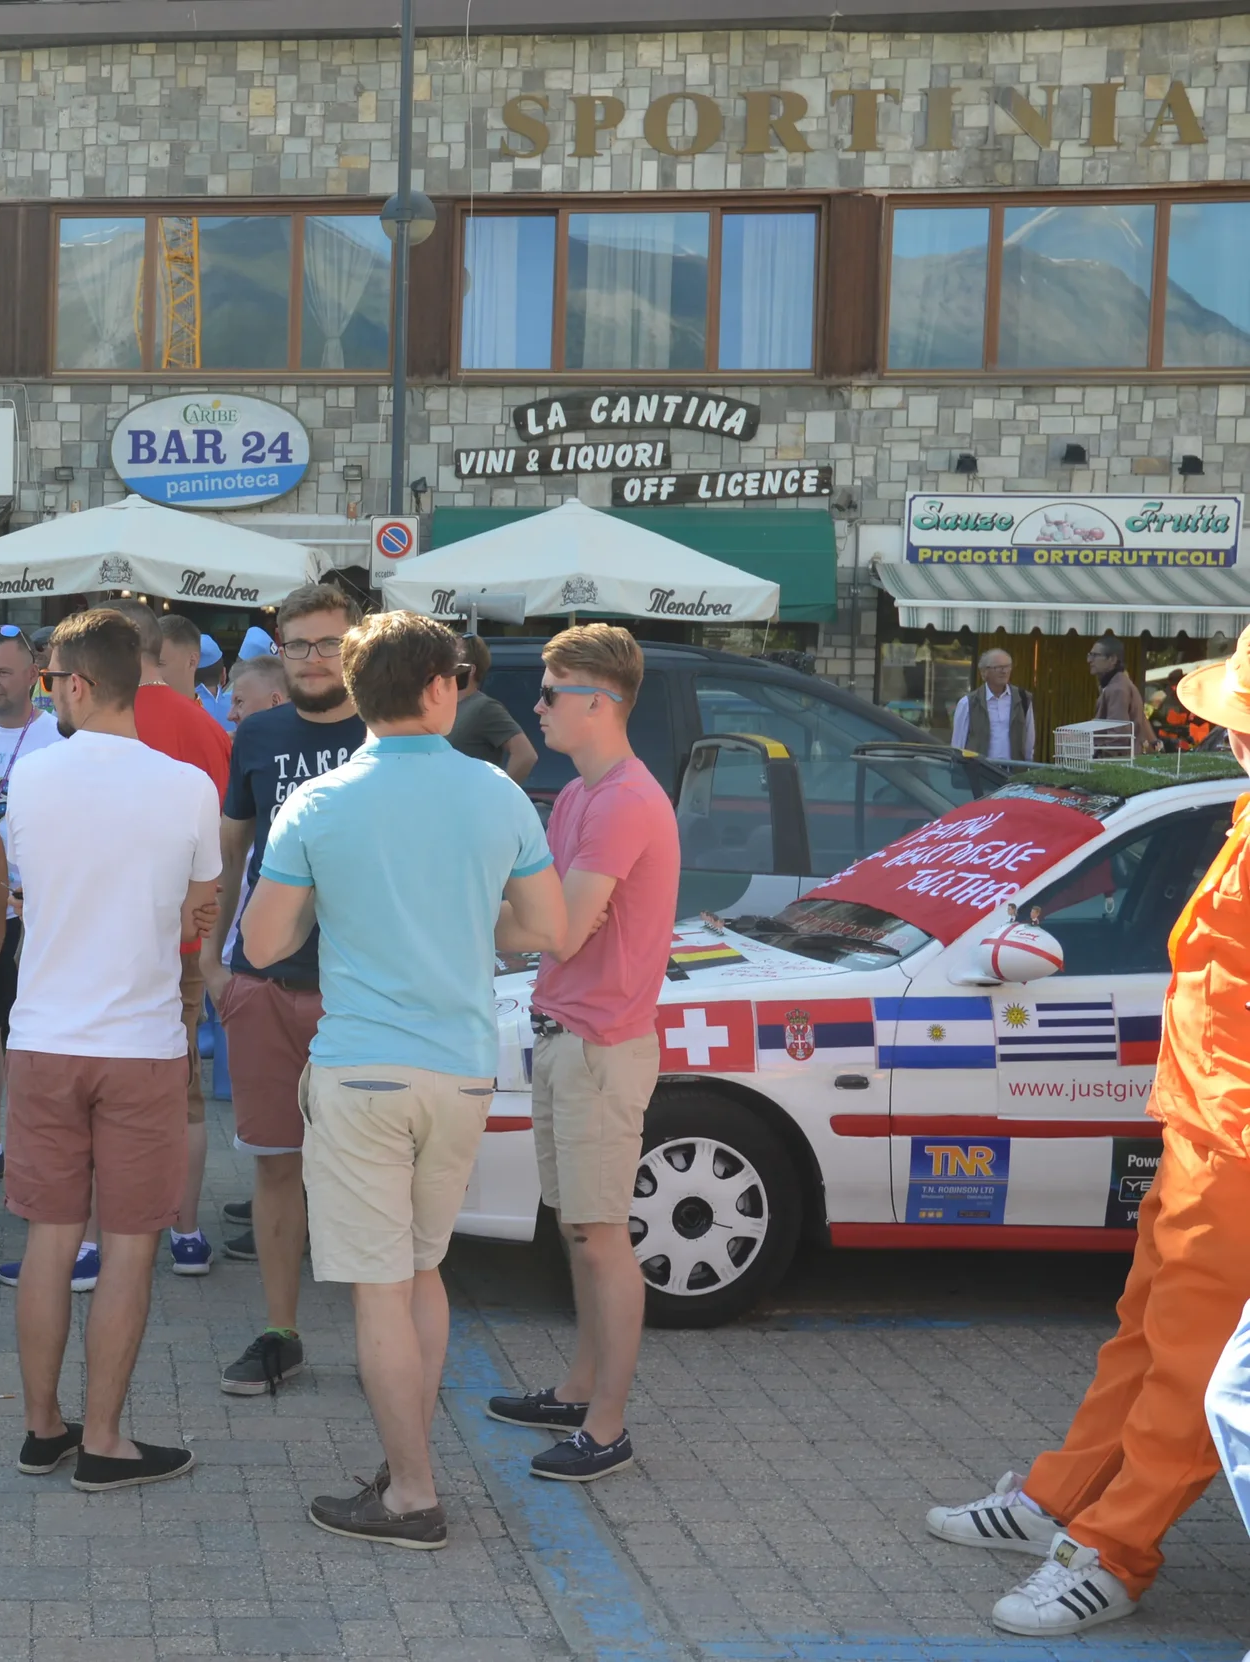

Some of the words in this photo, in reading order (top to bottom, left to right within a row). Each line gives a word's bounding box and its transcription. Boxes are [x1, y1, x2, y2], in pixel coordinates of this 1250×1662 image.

[499, 80, 1209, 158] SPORTINIA
[527, 401, 567, 436] LA
[590, 394, 749, 436] CANTINA
[127, 429, 227, 464] BAR
[241, 431, 293, 464] 24
[459, 449, 516, 475] VINI
[525, 448, 540, 472] &
[549, 441, 665, 471] LIQUORI
[166, 473, 279, 499] paninoteca
[623, 477, 677, 503] OFF
[913, 500, 1014, 532] Sauze
[1125, 502, 1230, 533] Frutta
[918, 548, 1018, 564] Prodotti
[1034, 549, 1225, 567] ORTOFRUTTICOLI
[177, 569, 260, 602] Menabrea
[645, 587, 732, 617] Menabrea
[1008, 1079, 1153, 1102] www.justgivi
[924, 1145, 996, 1177] TNR
[938, 1186, 979, 1194] ROBINSON
[980, 1186, 995, 1194] LTD
[1126, 1181, 1153, 1191] YE
